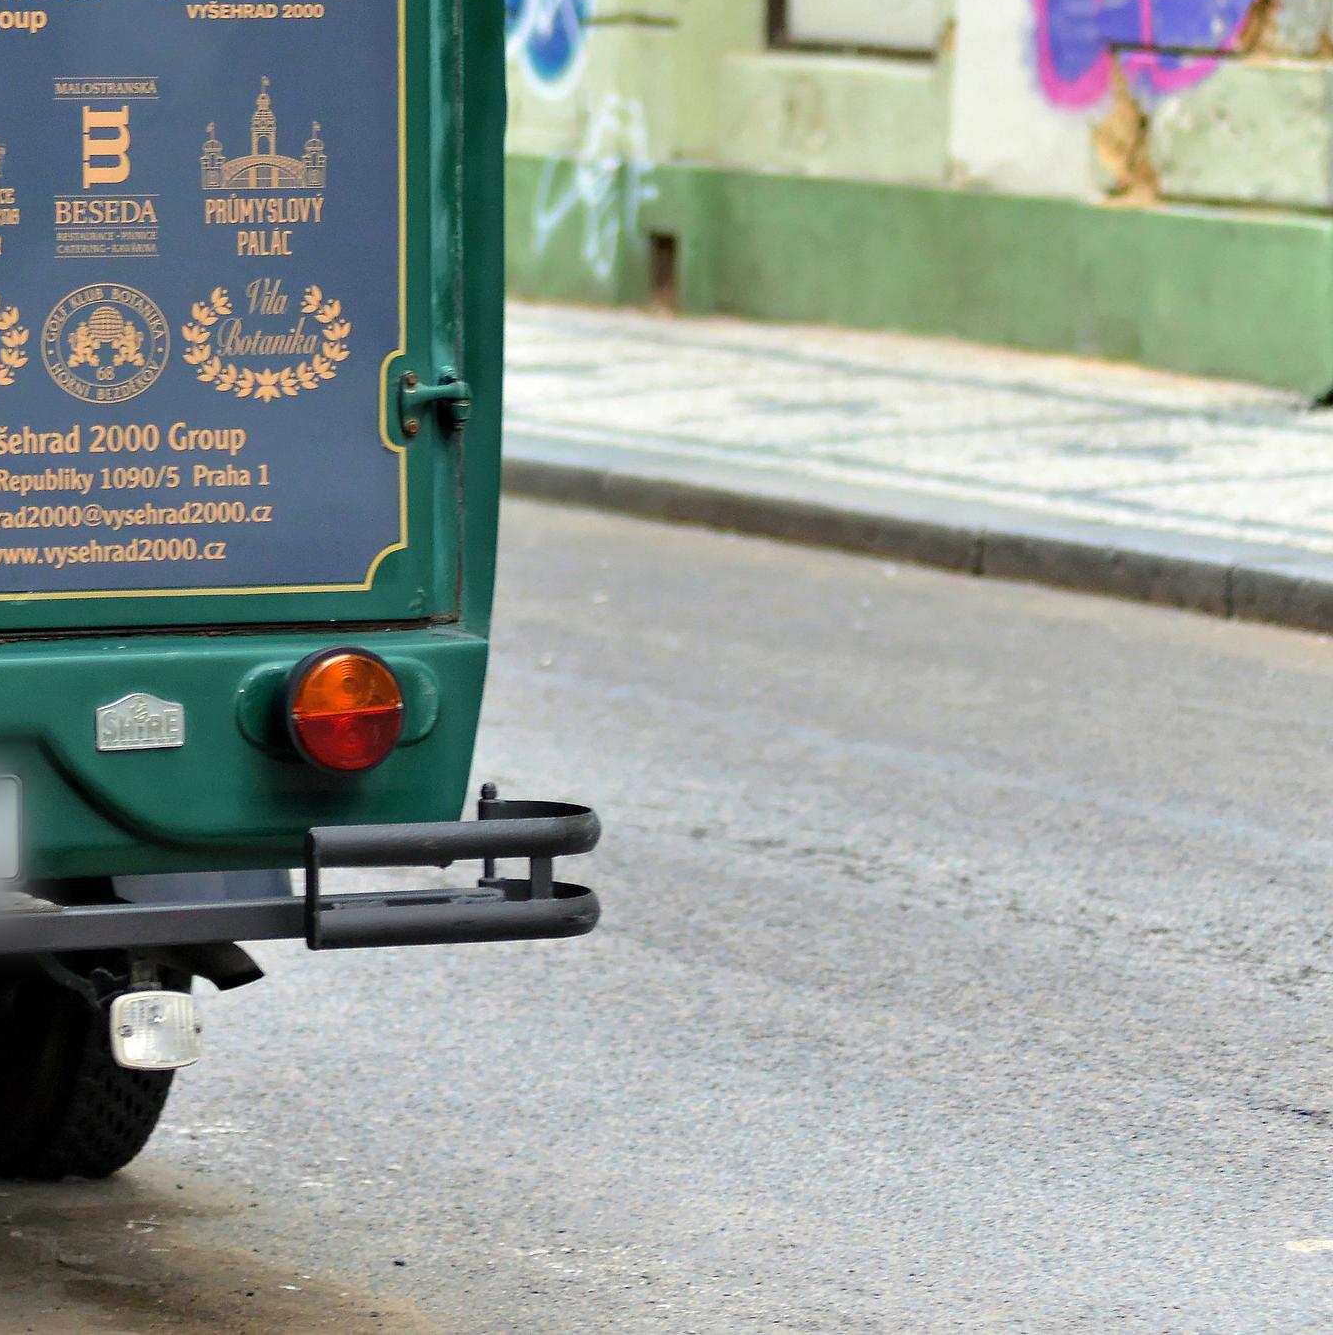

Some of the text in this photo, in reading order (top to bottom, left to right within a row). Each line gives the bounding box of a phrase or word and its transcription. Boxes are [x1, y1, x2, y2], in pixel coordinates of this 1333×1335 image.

[187, 1, 325, 19] VYŠEHRAD 2000
[54, 81, 158, 96] MALOSTRANSKÁ
[55, 200, 157, 224] BESEDA
[205, 196, 323, 223] PRŮMYSLOVÝ
[238, 230, 292, 256] PALÁC
[246, 277, 288, 316] Vila
[215, 316, 319, 358] Botanika
[89, 424, 160, 453] 2000
[168, 421, 246, 456] Group
[102, 466, 180, 490] 1090/5
[193, 464, 251, 486] Praha
[260, 464, 268, 485] 1
